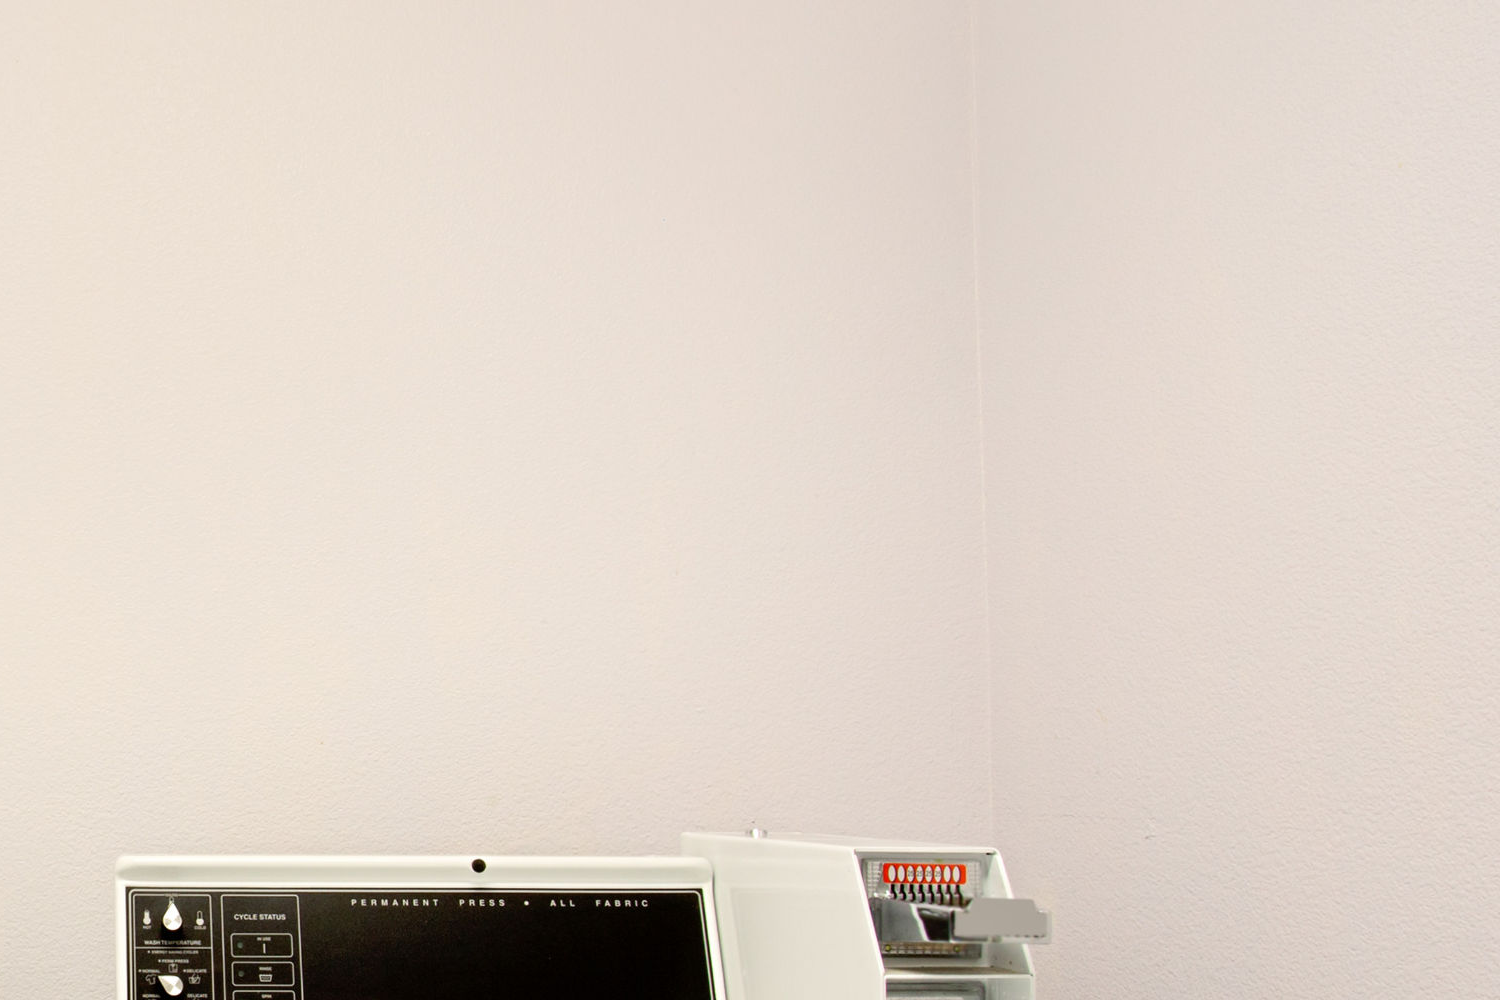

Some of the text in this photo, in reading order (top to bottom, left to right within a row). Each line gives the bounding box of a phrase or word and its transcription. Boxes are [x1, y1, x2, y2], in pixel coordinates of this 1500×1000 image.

[350, 898, 649, 908] PERMANENT PRESS ALL FABRIC
[233, 913, 287, 921] CYCLE STATUS
